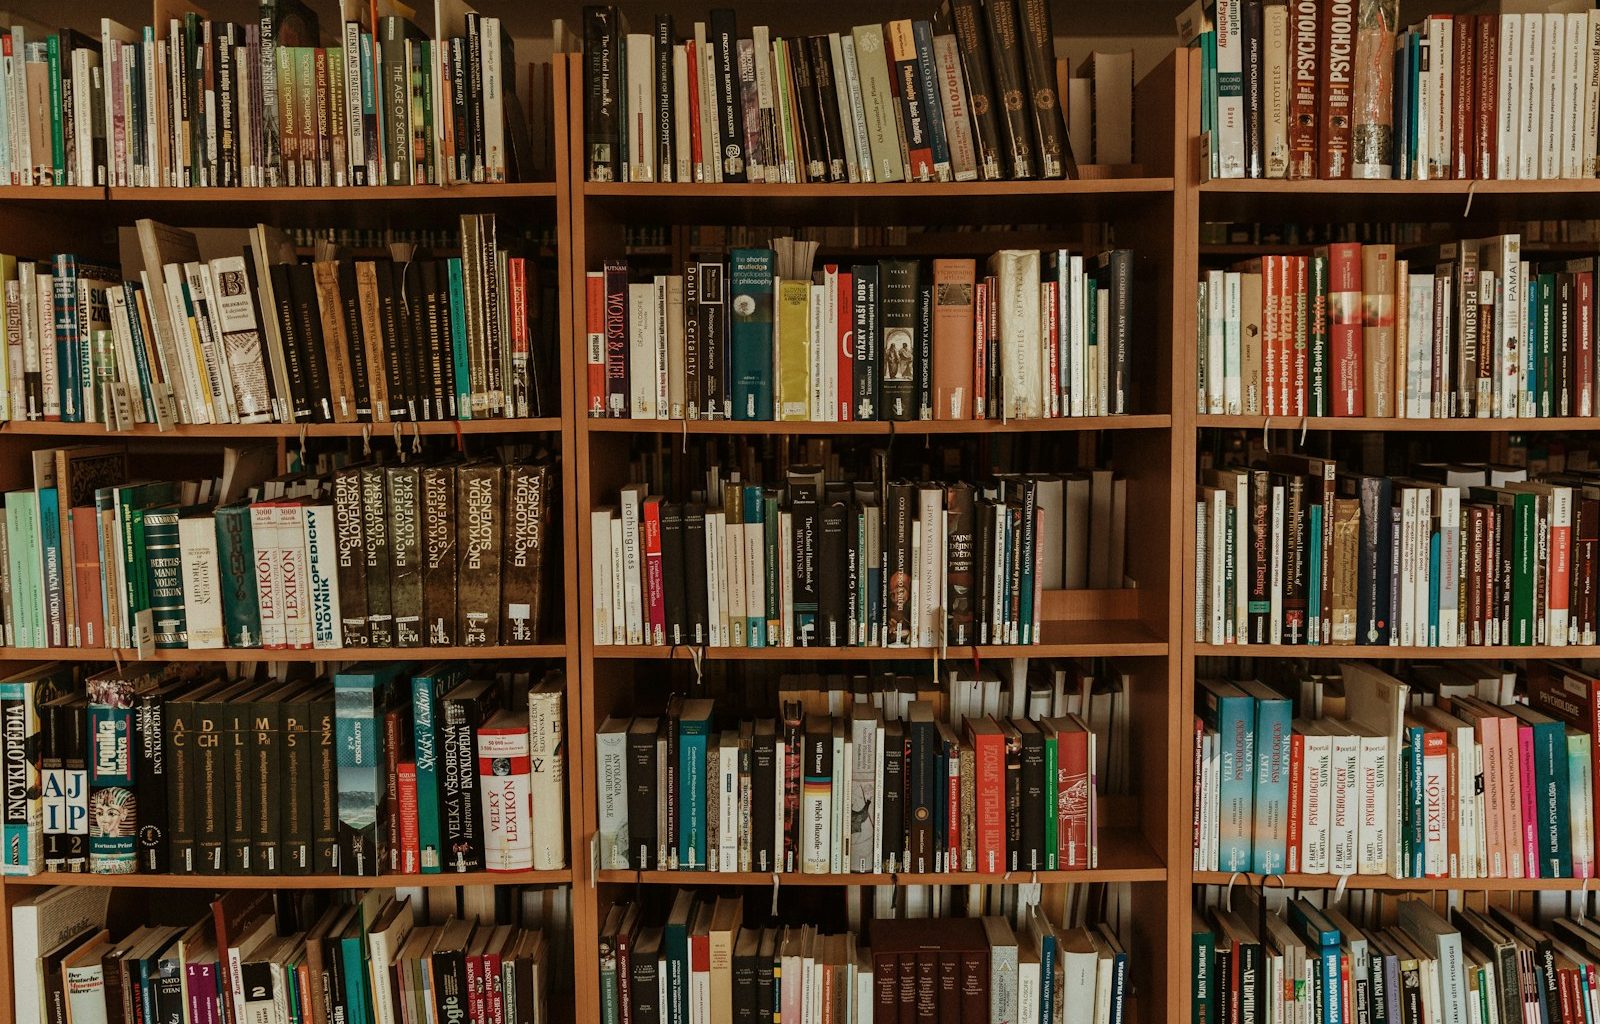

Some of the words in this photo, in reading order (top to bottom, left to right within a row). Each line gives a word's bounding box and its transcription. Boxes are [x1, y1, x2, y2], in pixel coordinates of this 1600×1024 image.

[349, 28, 357, 54] PATENTS
[602, 34, 610, 48] The
[660, 23, 668, 44] LEITER
[1218, 1, 1228, 48] Psychology
[350, 56, 358, 68] AND
[602, 49, 610, 72] Oxford
[1250, 38, 1258, 63] APPLIED
[350, 70, 359, 102] STRATEGIC
[394, 66, 403, 82] THE
[602, 74, 610, 107] Handbook
[904, 65, 916, 101] Philosophy
[922, 46, 936, 106] PHILOSOPHY
[1250, 64, 1258, 112] EVOLUTIONARY
[394, 84, 404, 104] AGE
[455, 78, 464, 106] Slovník
[946, 64, 963, 118] FILOZOFIE
[285, 88, 294, 135] Akademická
[302, 88, 312, 136] Akademická
[318, 88, 327, 137] Akademická
[352, 104, 361, 136] INVENTING
[395, 106, 404, 120] OF
[660, 94, 669, 145] PHILOSOPHY
[726, 106, 735, 138] LEKSYKON
[910, 101, 918, 118] Basic
[395, 122, 406, 161] SCIENCE
[912, 118, 928, 144] Readings
[687, 267, 697, 302] Doubt
[739, 278, 772, 286] philosophy
[858, 278, 866, 301] DOBY
[608, 292, 624, 338] WORDS
[856, 304, 866, 325] NAŠÍ
[1264, 294, 1278, 341] Vazba
[1278, 295, 1292, 342] Vazba
[1465, 291, 1478, 362] PERSONALITY
[592, 334, 600, 362] PHILOSOPHY
[608, 341, 624, 352] &
[686, 320, 697, 376] Certainty
[856, 328, 866, 361] OTÁZKY
[1313, 340, 1324, 372] Bowlby
[1346, 329, 1354, 359] Personality
[42, 344, 54, 394] Slovník
[204, 344, 222, 397] CHRONOLÓGIA
[608, 354, 624, 379] LIFE
[1280, 348, 1290, 383] Bowlby
[1294, 353, 1305, 386] Bowlby
[1346, 360, 1354, 378] Theory
[1313, 376, 1322, 396] John
[123, 504, 132, 522] public
[336, 474, 352, 568] ENCYKLOPÉDIA
[350, 475, 362, 548] SLOVENSKA
[363, 473, 377, 567] ENCYKLOPÉDIA
[376, 475, 386, 546] SLOVENSKA
[396, 475, 406, 567] ENCYKLOPÉDIA
[404, 475, 414, 546] SLOVENSKA
[428, 474, 439, 568] ENCYKLOPÉDIA
[437, 477, 447, 549] SLOVENSKA
[468, 478, 481, 570] ENCYKLOPÉDIA
[480, 478, 492, 550] SLOVENSKA
[514, 476, 528, 568] ENCYKLOPÉDIA
[526, 476, 540, 547] SLOVENSKA
[125, 522, 133, 545] internet
[624, 503, 635, 570] nothingness
[1254, 504, 1268, 561] Psychological
[1475, 519, 1483, 541] FREUD
[1538, 518, 1546, 560] psychologie
[47, 546, 60, 591] INFORMAČNÁ
[796, 528, 804, 579] METAPHYSICS
[805, 552, 813, 584] Handbook
[154, 568, 177, 577] MANN
[191, 560, 202, 604] THOUGHT
[200, 561, 211, 604] MODERN
[256, 550, 274, 619] LEXIKÓN
[284, 550, 299, 620] LEXIKÓN
[1253, 560, 1267, 596] Testing
[50, 592, 61, 625] VÝCHOVA
[1539, 691, 1580, 716] PSYCHOLOGIE
[144, 704, 152, 758] SLOVENSKÁ
[154, 705, 162, 775] ENCYKLOPÉDIA
[173, 718, 184, 730] A
[198, 734, 218, 747] CH
[202, 720, 214, 732] D
[234, 734, 244, 746] L
[255, 718, 270, 730] M
[288, 734, 296, 747] S
[96, 720, 116, 776] Kronika
[354, 721, 362, 764] SLOVENSKO
[456, 726, 473, 789] ENCYKLOPÉDIA
[1245, 731, 1254, 773] SLOVNÍK
[3, 704, 27, 821] ENCYKLOPÉDIA
[442, 725, 459, 796] VŠEOBECNÁ
[815, 754, 823, 774] Durant
[1320, 754, 1328, 788] SLOVNÍK
[1347, 756, 1356, 788] SLOVNÍK
[1376, 755, 1385, 788] SLOVNÍK
[43, 772, 64, 798] A
[67, 772, 83, 798] J
[1308, 767, 1319, 826] PSYCHOLOGICKÝ
[1336, 767, 1346, 826] PSYCHOLOGICKÝ
[1366, 767, 1375, 826] PSYCHOLOGICKÝ
[47, 804, 59, 830] I
[68, 805, 86, 831] P
[463, 792, 473, 839] ilustrovaná
[502, 780, 518, 842] LEXIKÓN
[814, 800, 823, 823] Příběh
[1428, 774, 1440, 842] LEXIKÓN
[50, 836, 58, 853] 1
[70, 836, 82, 853] 2
[814, 823, 822, 850] filozofie
[1366, 842, 1374, 861] HARTL
[189, 966, 196, 976] 1
[202, 966, 210, 976] 2
[467, 962, 475, 992] FILOSOFIE
[484, 960, 492, 990] FILOSOFIE
[620, 956, 628, 978] filozofov
[1326, 954, 1337, 977] UMĚNÍ
[1544, 950, 1556, 991] psychologie
[252, 986, 266, 998] 2
[1329, 978, 1338, 1023] PSYCHOLOGIE
[1357, 982, 1368, 1010] Expressing
